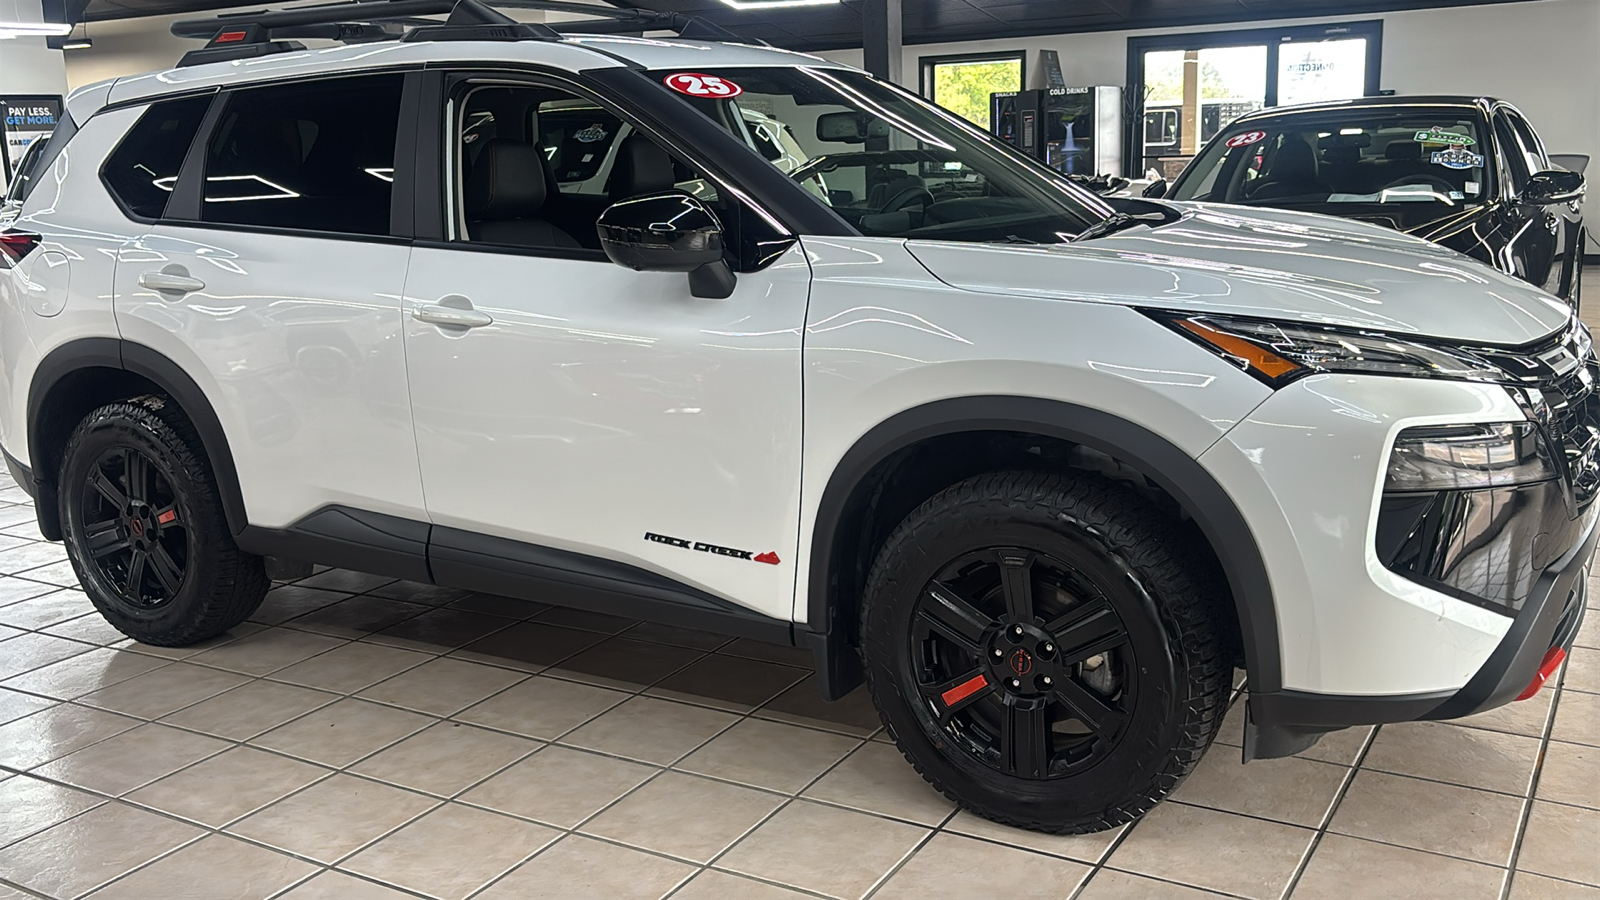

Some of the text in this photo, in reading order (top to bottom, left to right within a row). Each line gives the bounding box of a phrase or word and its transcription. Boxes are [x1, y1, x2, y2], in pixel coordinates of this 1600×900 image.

[678, 76, 731, 95] 25
[1049, 86, 1089, 96] COLD DRINKS
[8, 107, 53, 116] PAY LESS.
[6, 116, 57, 125] GET MORE.
[9, 138, 34, 146] CARCO
[1231, 132, 1260, 146] 23
[644, 532, 754, 560] ROCK CREEK
